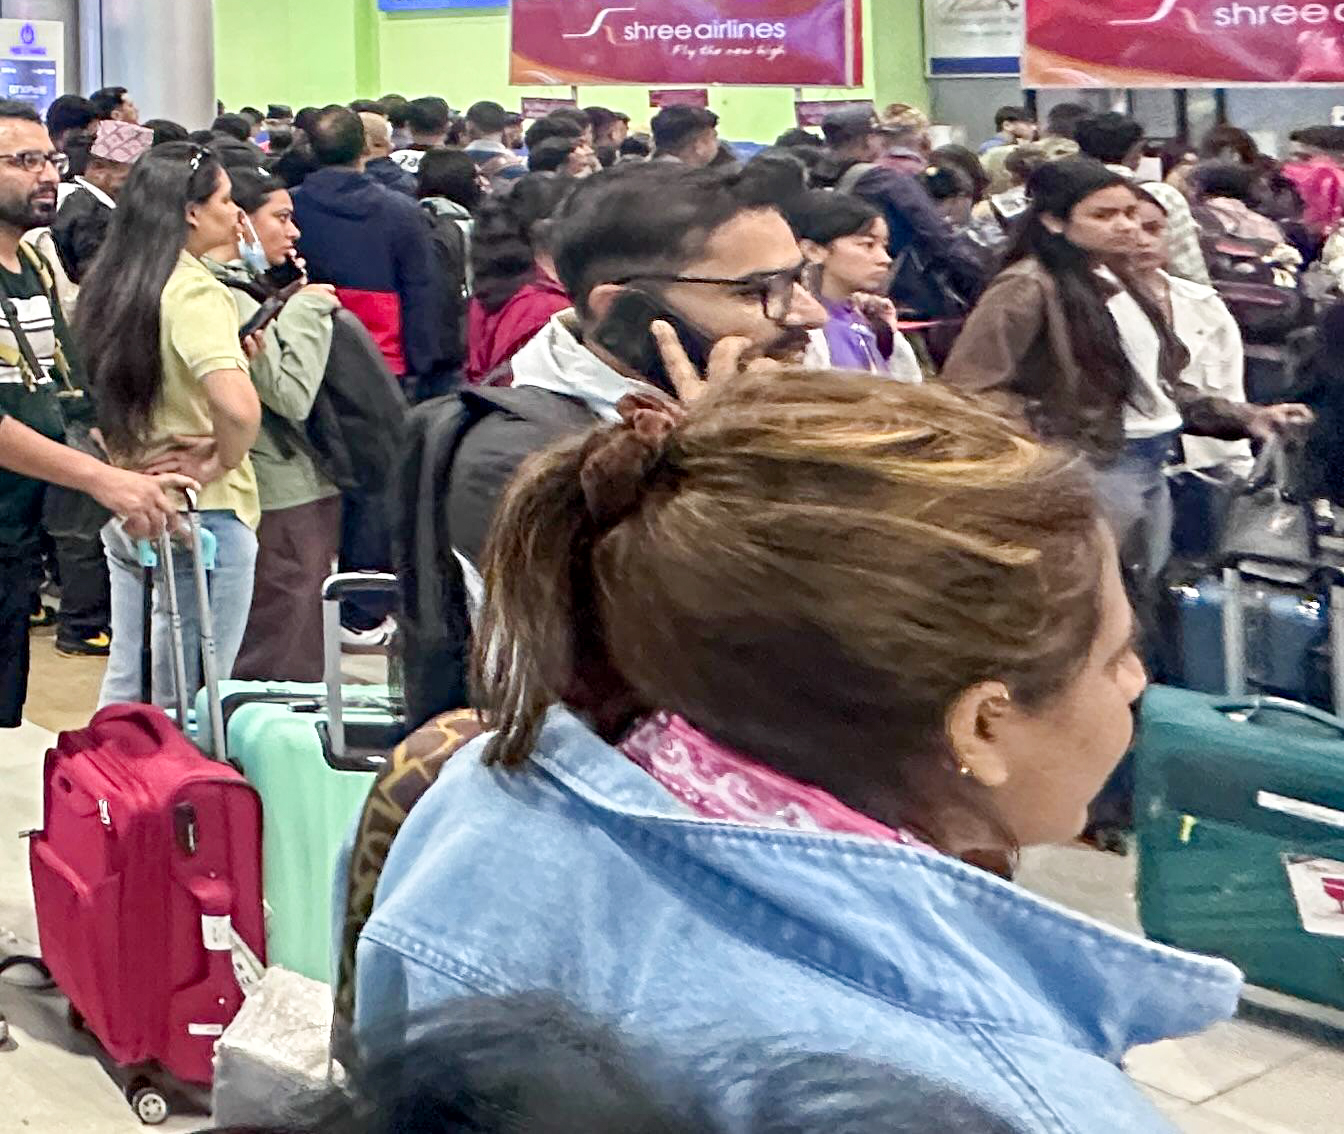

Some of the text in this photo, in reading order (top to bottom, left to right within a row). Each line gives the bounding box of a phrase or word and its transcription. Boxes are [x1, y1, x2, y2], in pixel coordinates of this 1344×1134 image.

[1215, 2, 1330, 27] shree
[624, 19, 786, 40] shree airlines
[672, 44, 786, 61] Fly the new high
